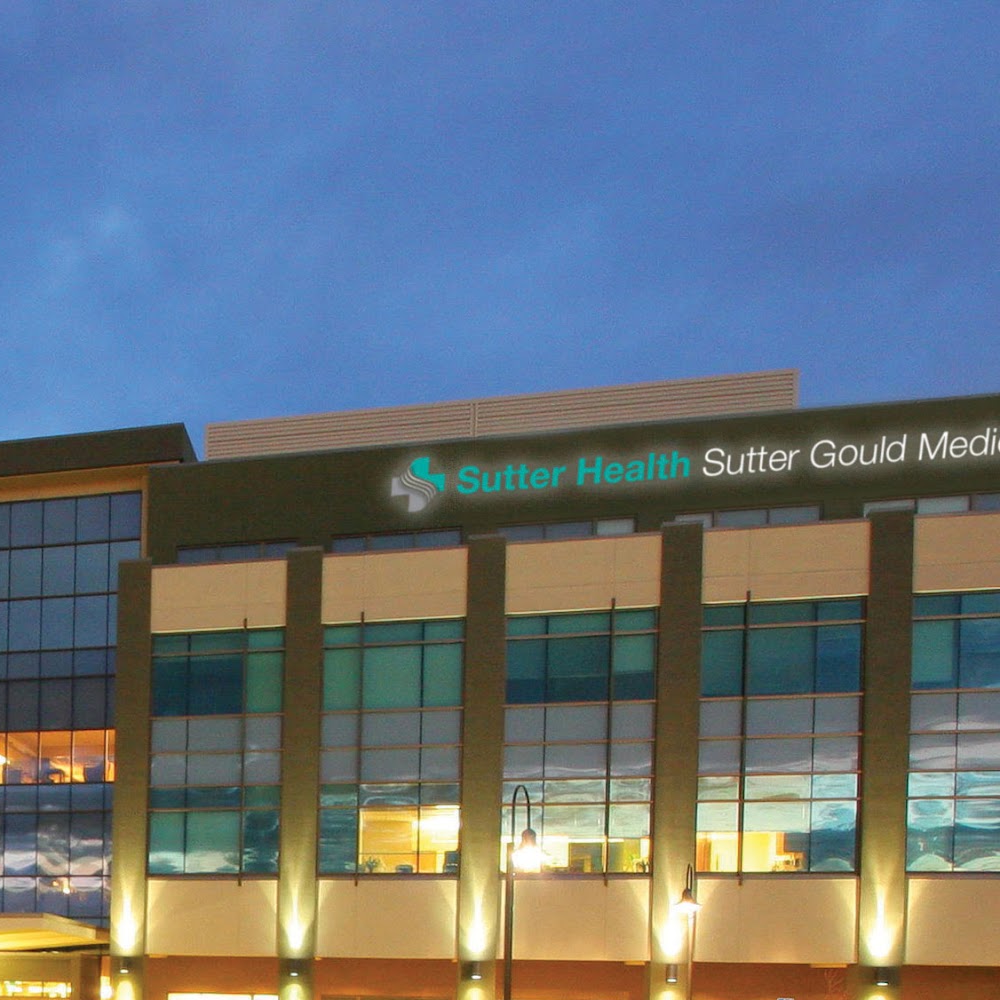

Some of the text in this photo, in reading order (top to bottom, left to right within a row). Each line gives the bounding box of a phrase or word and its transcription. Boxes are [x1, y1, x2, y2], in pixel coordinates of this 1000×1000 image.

[456, 427, 1000, 495] Sutter Health Sutter Gould Medi
